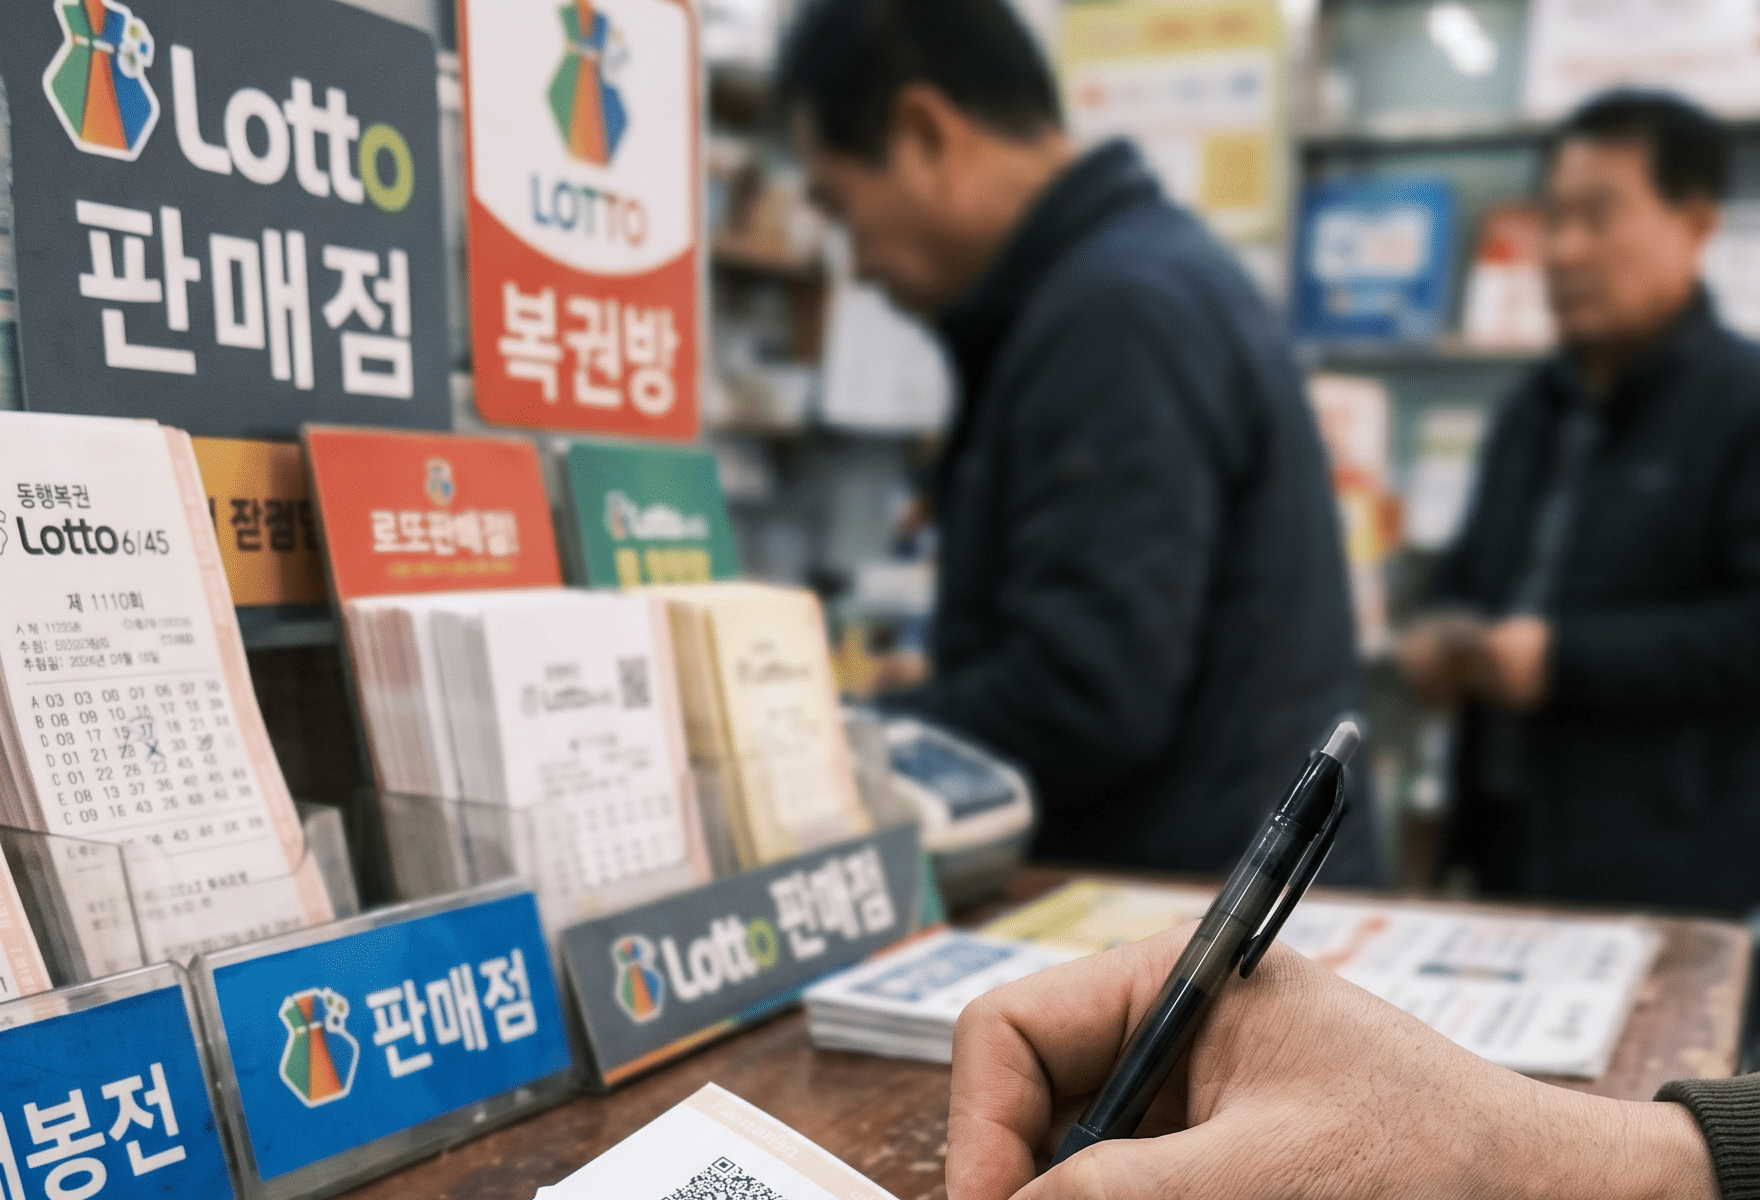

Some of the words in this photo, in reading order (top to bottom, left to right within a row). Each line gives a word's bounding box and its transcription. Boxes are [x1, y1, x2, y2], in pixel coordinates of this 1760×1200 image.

[171, 44, 414, 212] Lotto
[532, 174, 648, 247] LOTTO
[76, 199, 414, 400] 판매점
[498, 280, 680, 417] 복권방
[17, 483, 91, 509] 동행복권
[16, 516, 119, 556] Lotto
[32, 695, 40, 709] A
[45, 693, 65, 708] 03
[35, 715, 44, 729] B
[63, 752, 80, 766] 01
[91, 748, 108, 763] 21
[68, 771, 85, 785] 01
[96, 767, 114, 782] 22
[661, 915, 780, 1001] Lotto
[769, 846, 897, 960] 판매점
[365, 947, 538, 1079] 판매점
